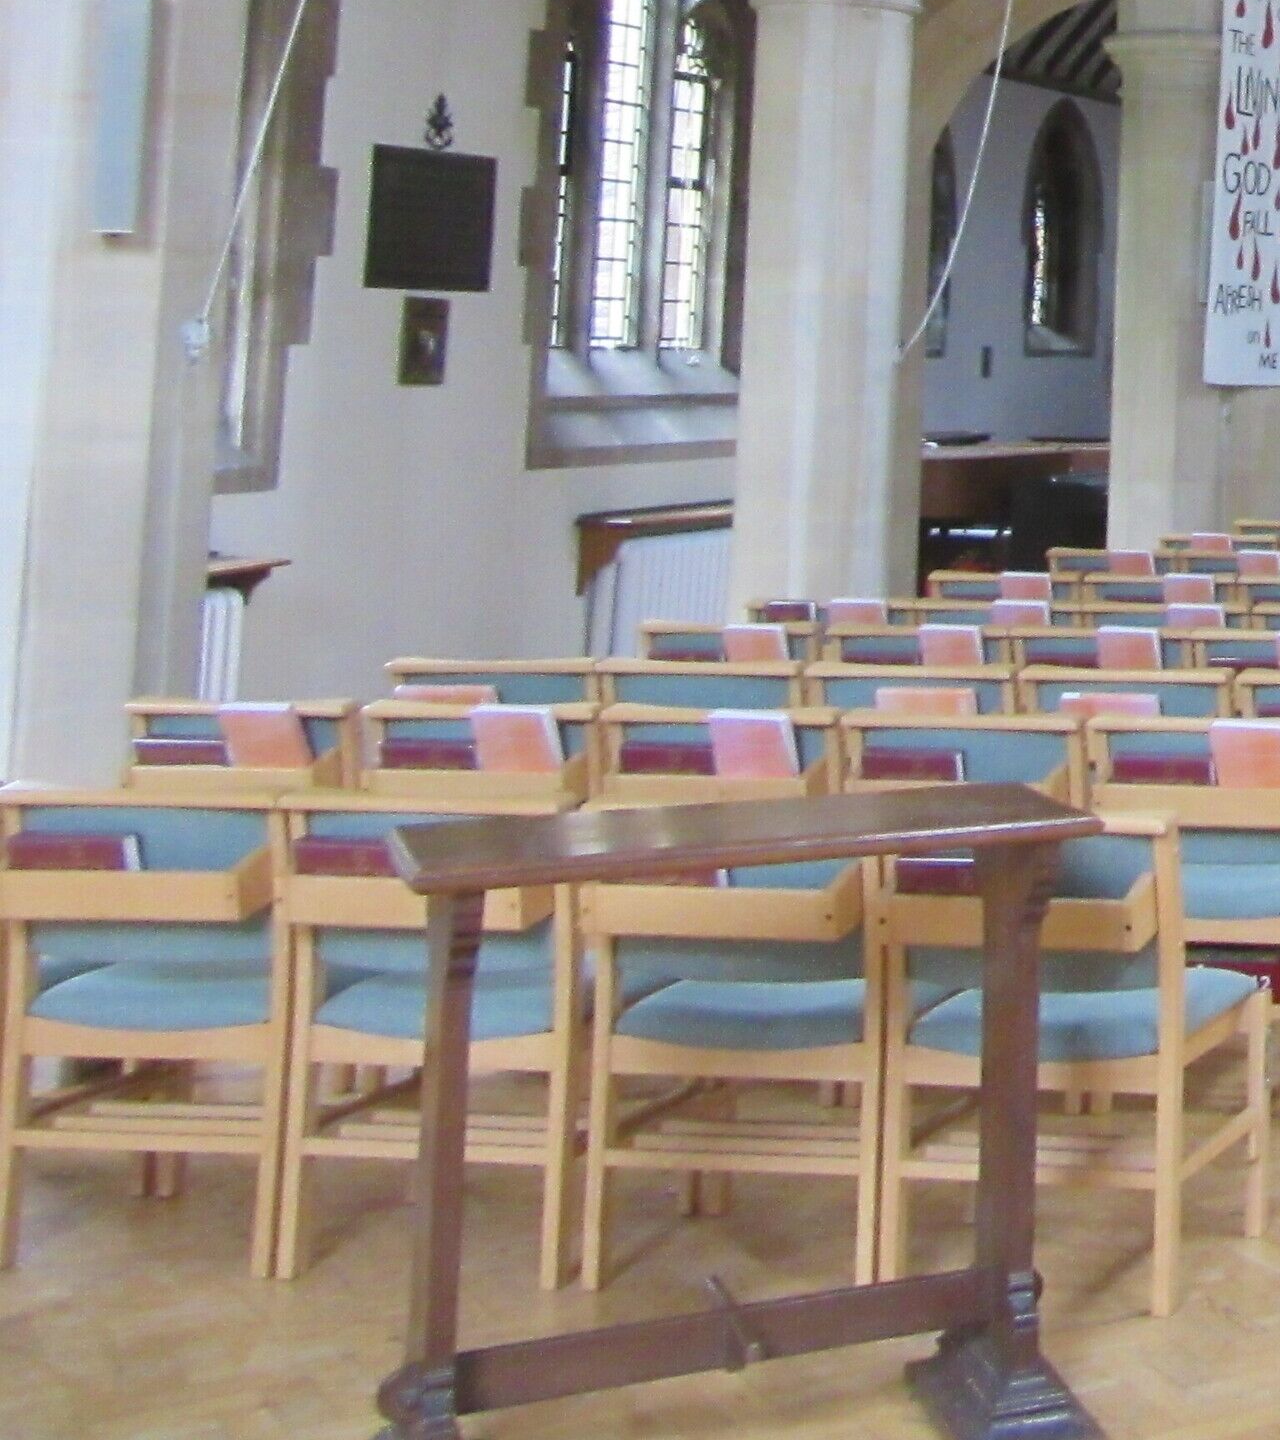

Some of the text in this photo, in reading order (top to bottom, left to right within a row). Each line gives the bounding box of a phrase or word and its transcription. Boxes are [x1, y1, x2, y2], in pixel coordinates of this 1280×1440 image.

[1229, 29, 1256, 57] THE
[1223, 153, 1271, 195] GOD
[1242, 210, 1274, 237] FALL
[1213, 284, 1264, 316] AFRESH
[1247, 330, 1260, 344] on
[1259, 352, 1278, 369] ME
